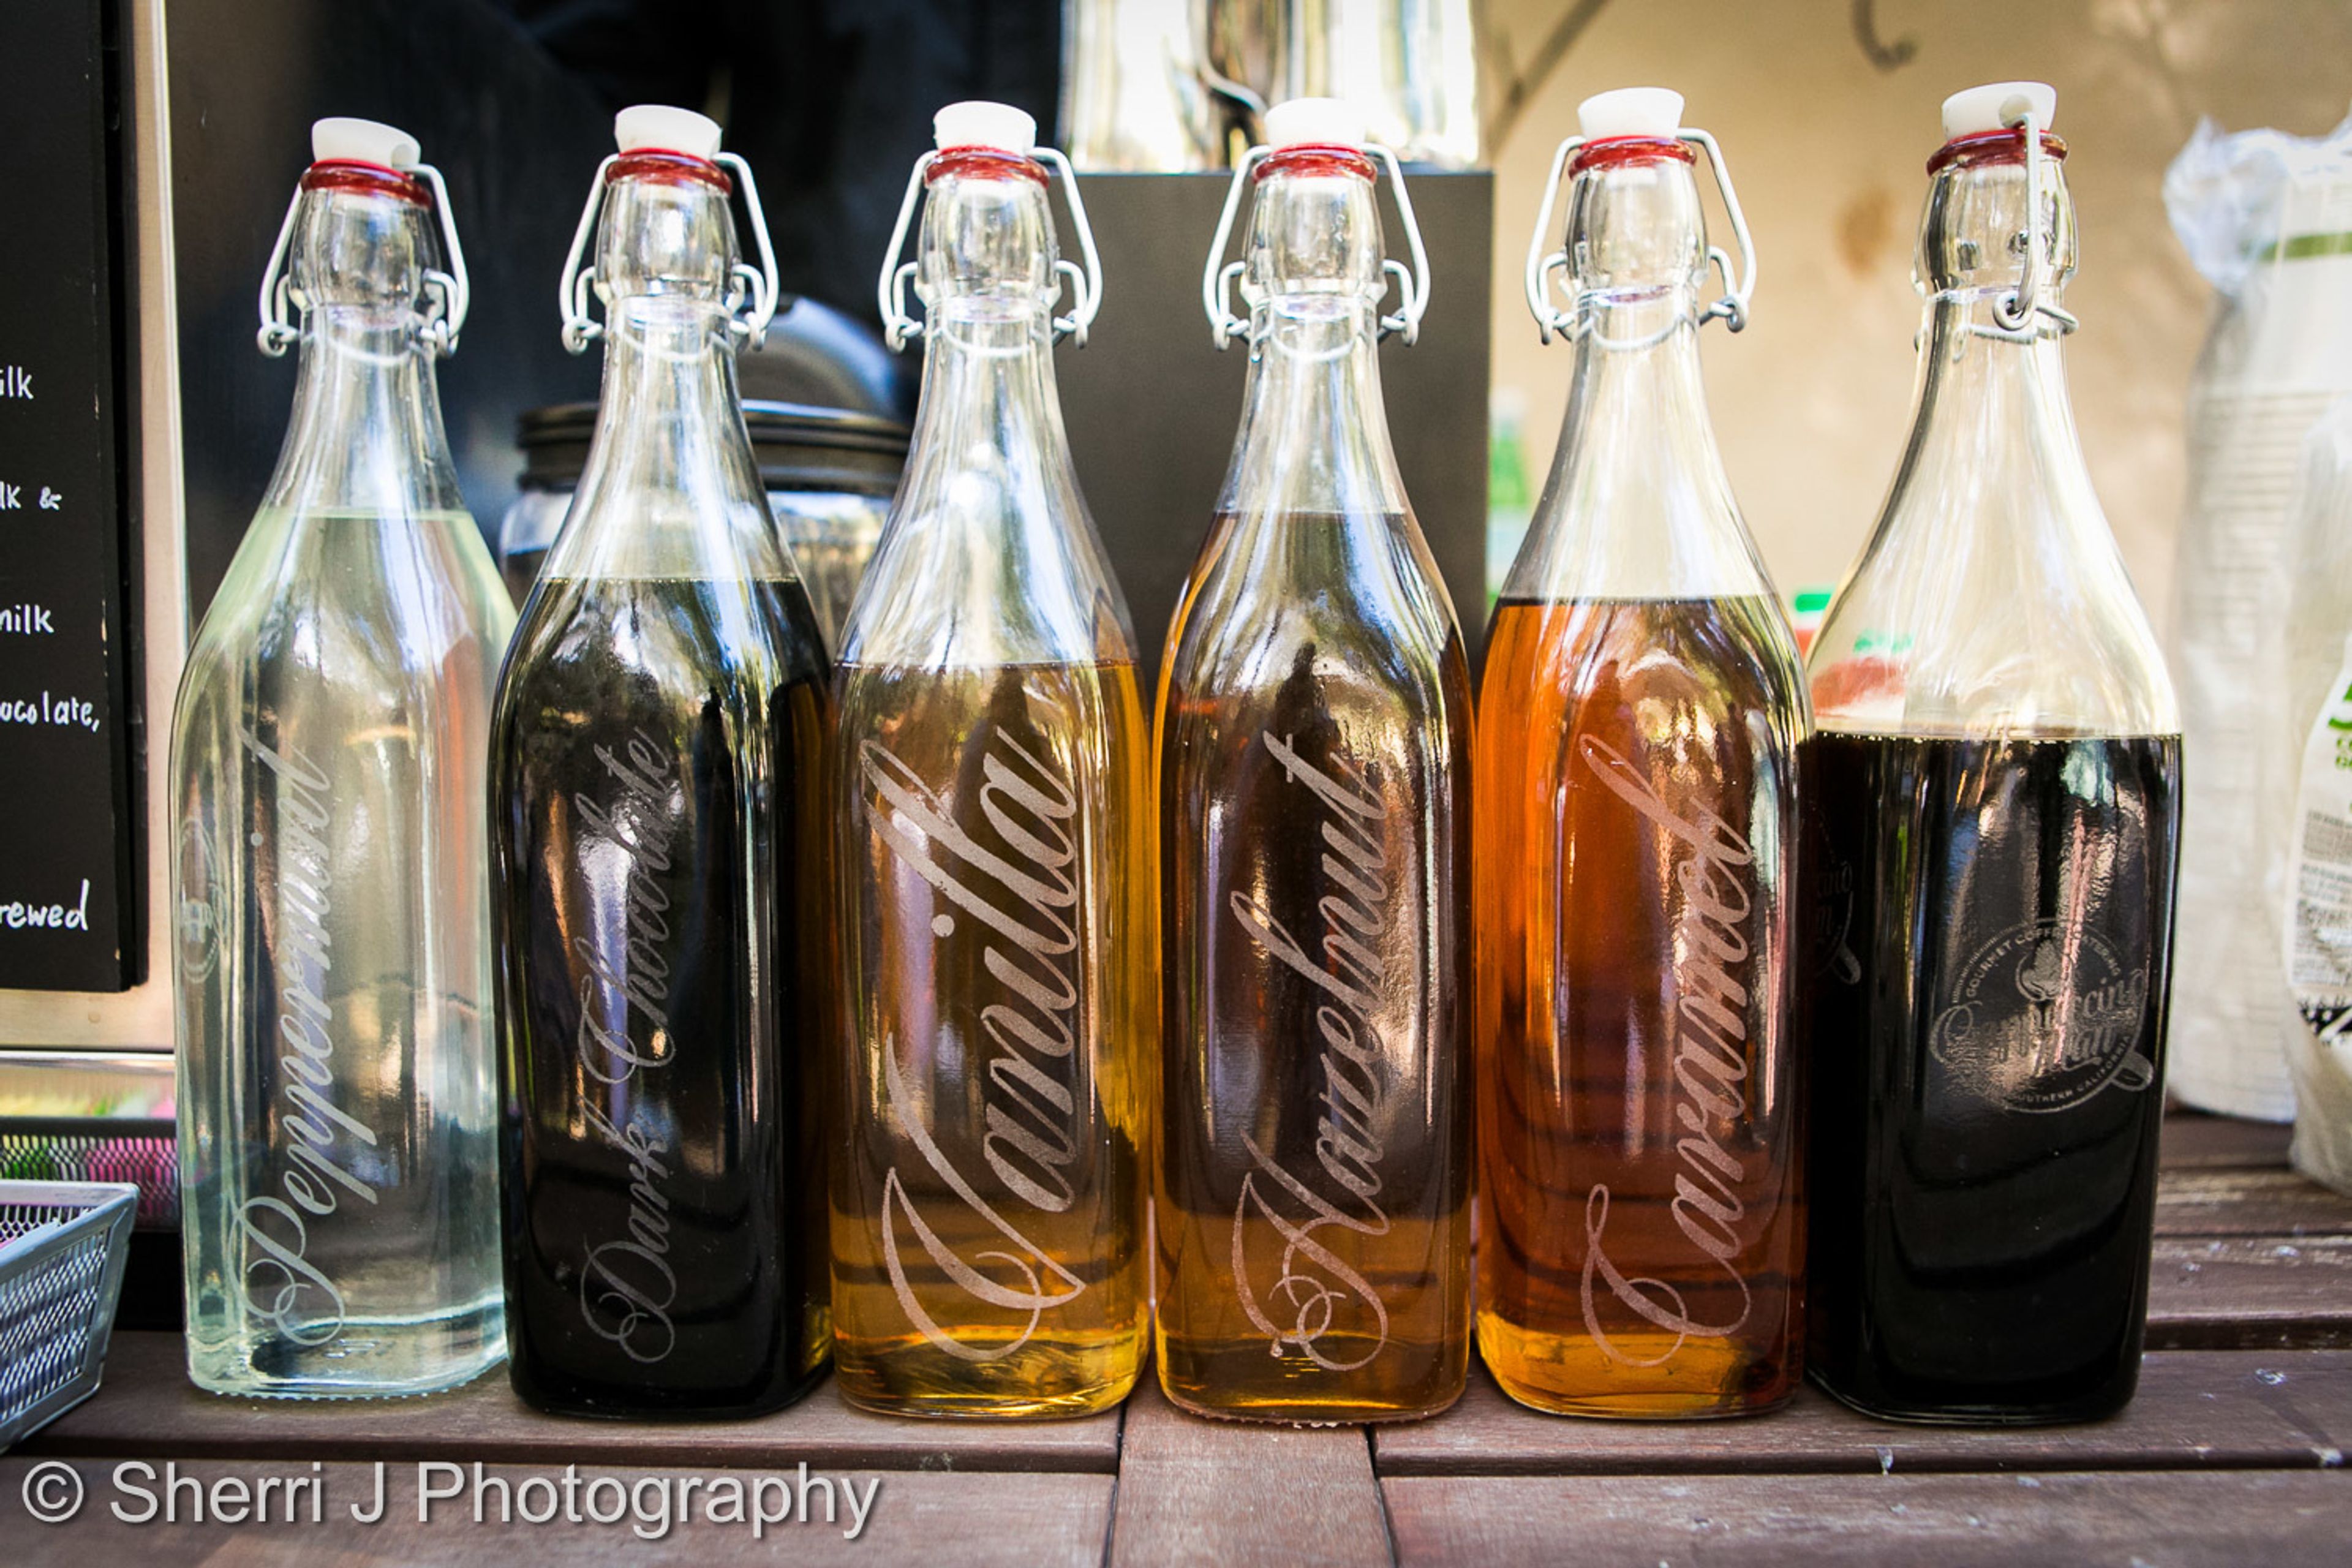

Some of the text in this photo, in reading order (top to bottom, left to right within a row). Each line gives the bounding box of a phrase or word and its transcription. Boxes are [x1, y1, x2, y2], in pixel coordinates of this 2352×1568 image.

[0, 365, 34, 399] ilk
[39, 486, 62, 511] &
[0, 690, 100, 733] ocolate,
[0, 877, 91, 932] rewed
[225, 722, 378, 1346] Peppermint
[574, 726, 677, 1364] Dark Chocolate
[859, 725, 1086, 1362] Vanilla
[1230, 729, 1390, 1373] Hazelnut
[1578, 733, 1754, 1368] Caramel
[1965, 940, 2012, 998] GOURMET
[2014, 927, 2068, 946] COFFE
